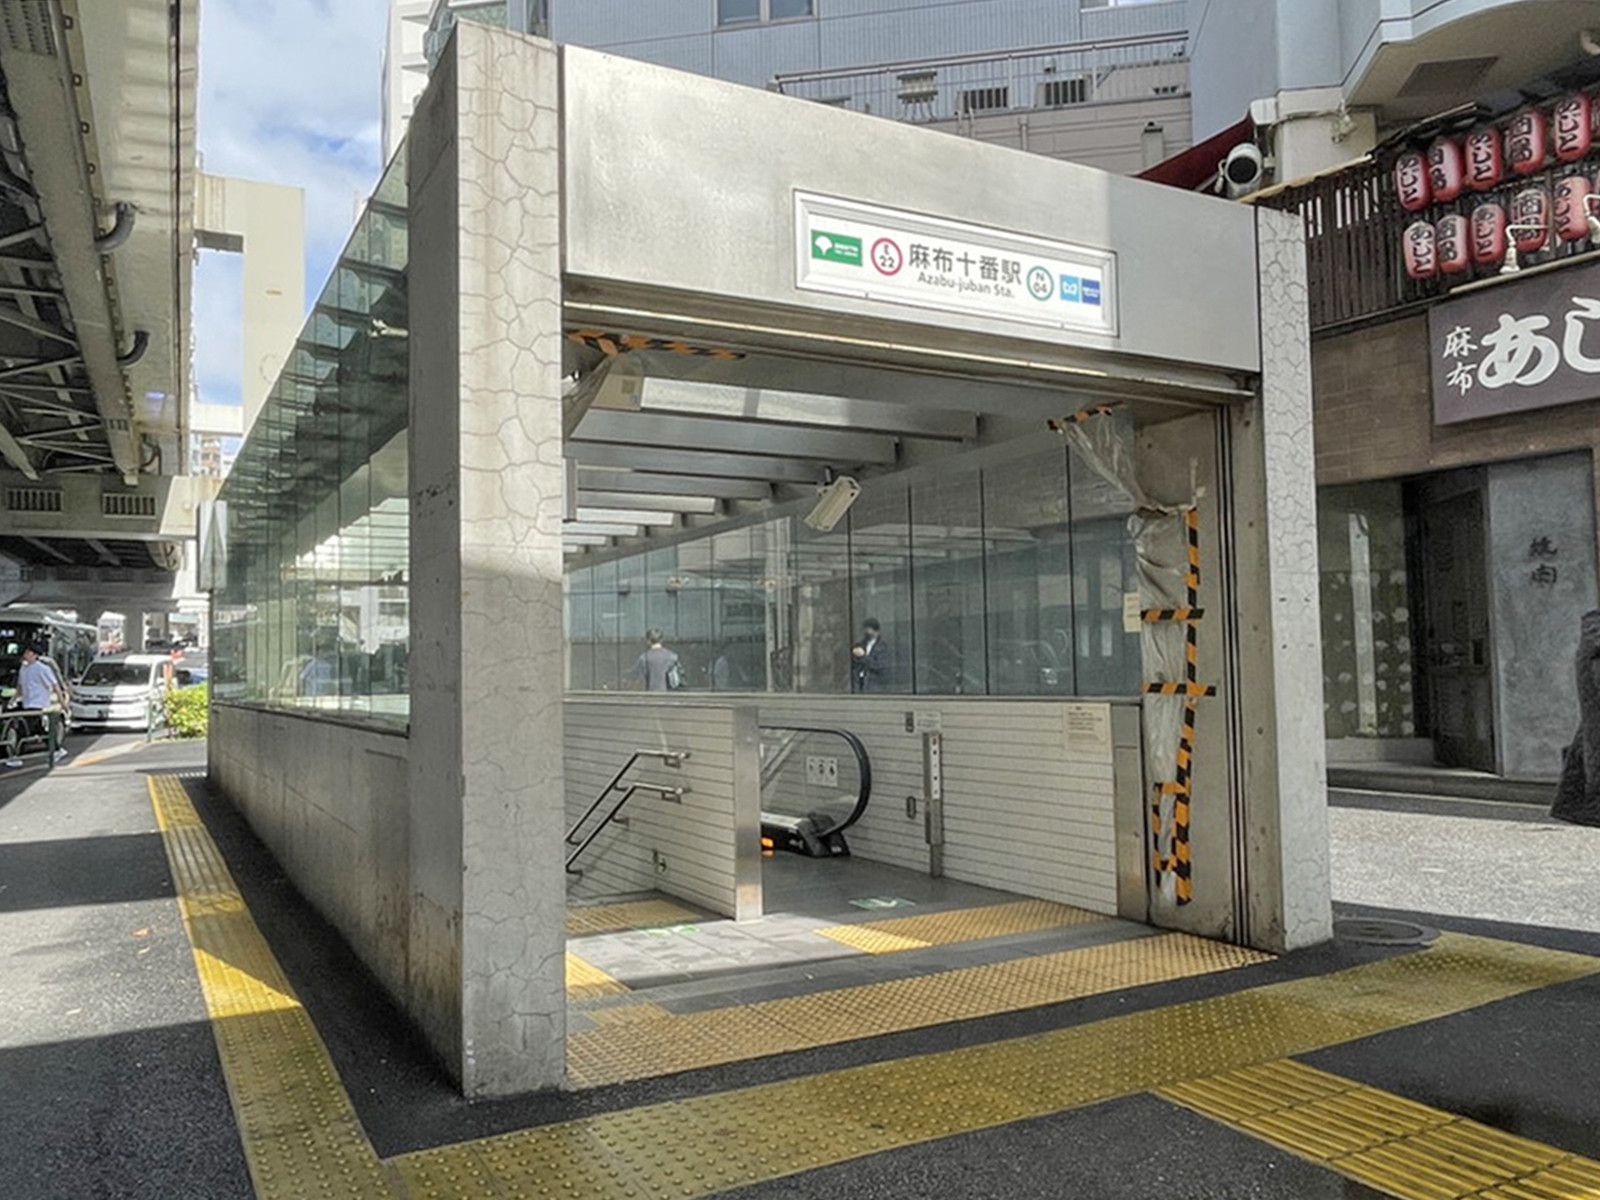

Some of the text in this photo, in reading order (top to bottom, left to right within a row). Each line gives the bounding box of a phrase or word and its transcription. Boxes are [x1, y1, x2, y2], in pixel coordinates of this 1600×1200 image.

[879, 255, 895, 268] 22
[908, 243, 1022, 285] 麻布十番駅
[918, 271, 1016, 298] Azabu-juban Sta.
[1033, 281, 1048, 294] 04
[1443, 325, 1478, 396] 麻布
